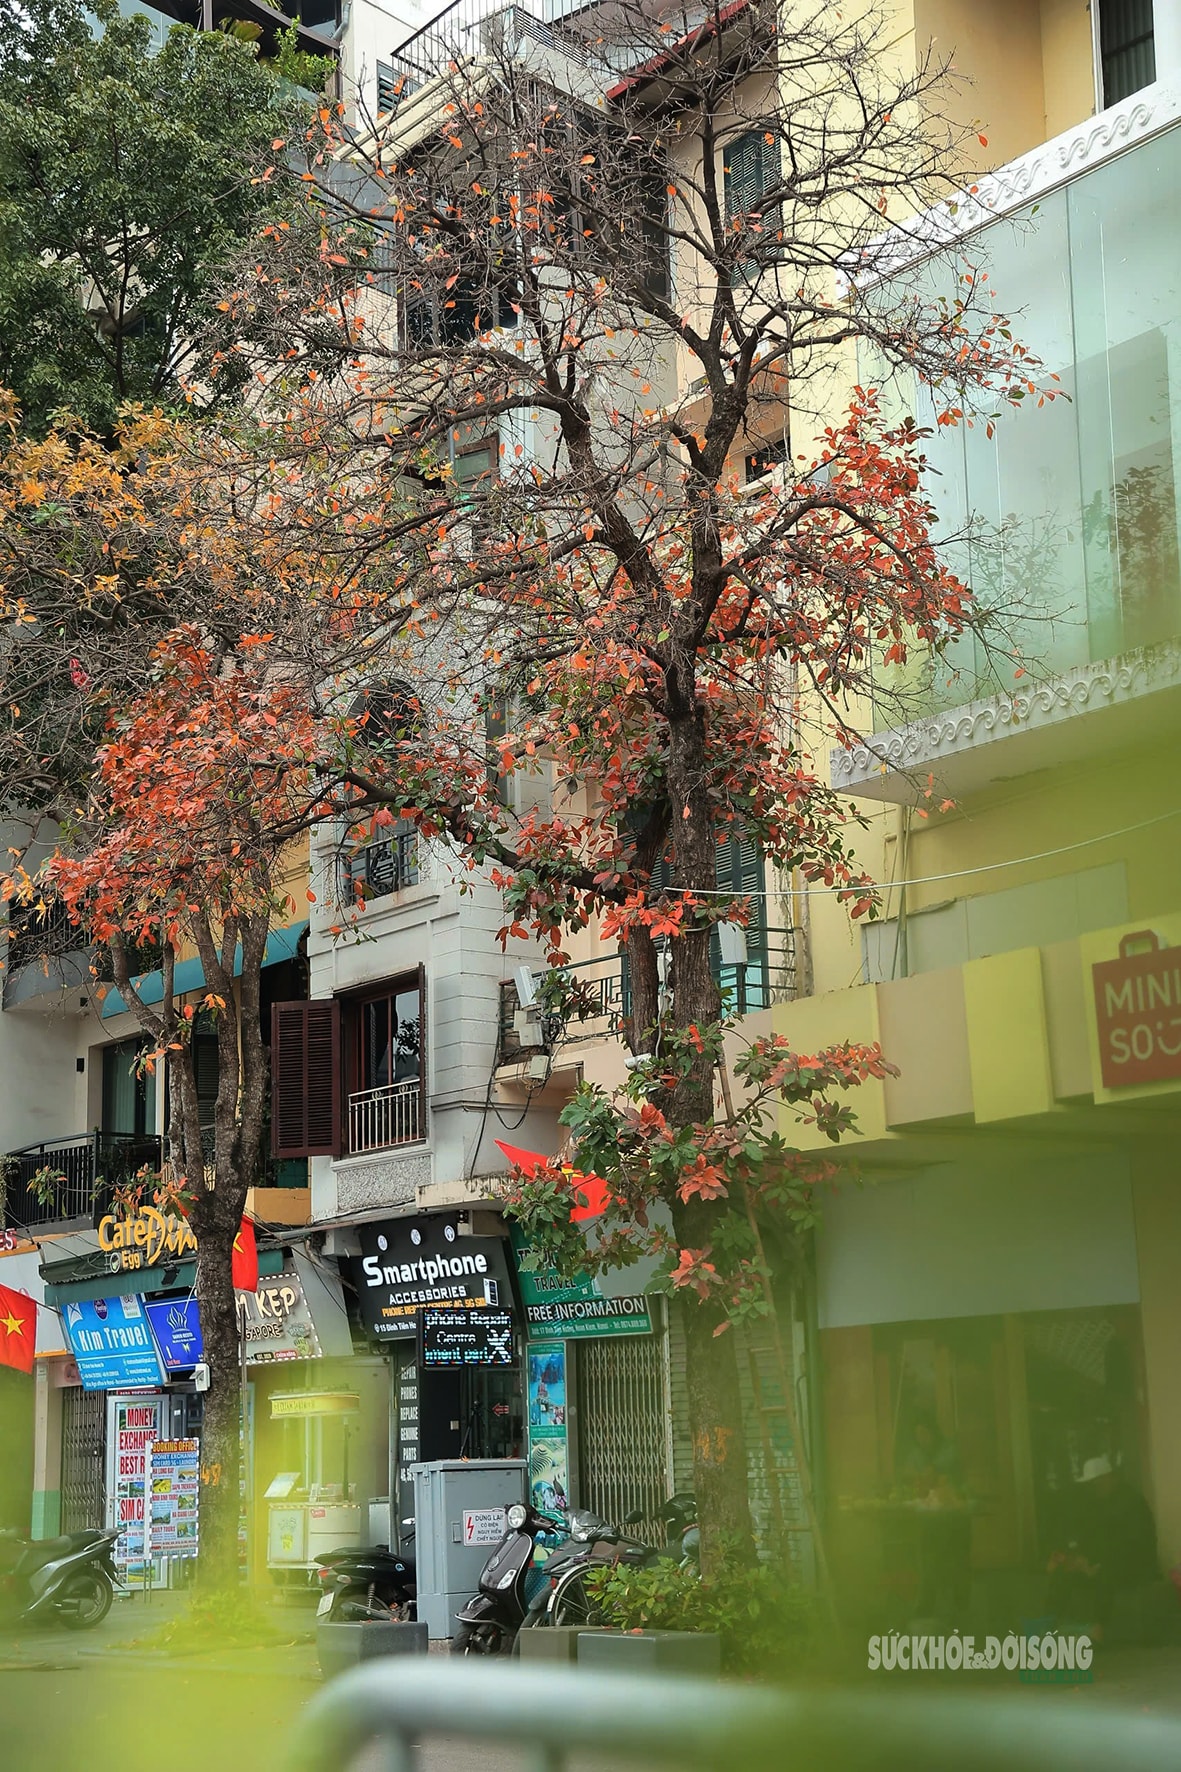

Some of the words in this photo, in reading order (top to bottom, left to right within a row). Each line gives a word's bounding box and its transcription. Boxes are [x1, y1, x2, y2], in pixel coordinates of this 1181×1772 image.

[1105, 968, 1181, 1018] MINI
[122, 1251, 141, 1269] Egg
[362, 1253, 488, 1287] Smartphone
[255, 1286, 296, 1323] KẸP
[389, 1285, 467, 1305] ACCESSORIES
[381, 1305, 405, 1317] PHONE
[527, 1304, 553, 1322] FREE
[555, 1297, 646, 1320] INFORMATION
[470, 1312, 510, 1329] Repair
[78, 1328, 104, 1352] Kim
[104, 1323, 149, 1349] Travel
[436, 1330, 476, 1345] Centre
[127, 1408, 154, 1427] MONEY
[152, 1441, 178, 1453] BOOKING
[178, 1440, 197, 1452] OFFICE
[402, 1447, 417, 1460] PARTS
[120, 1456, 140, 1475] BEST
[120, 1499, 135, 1521] SIM
